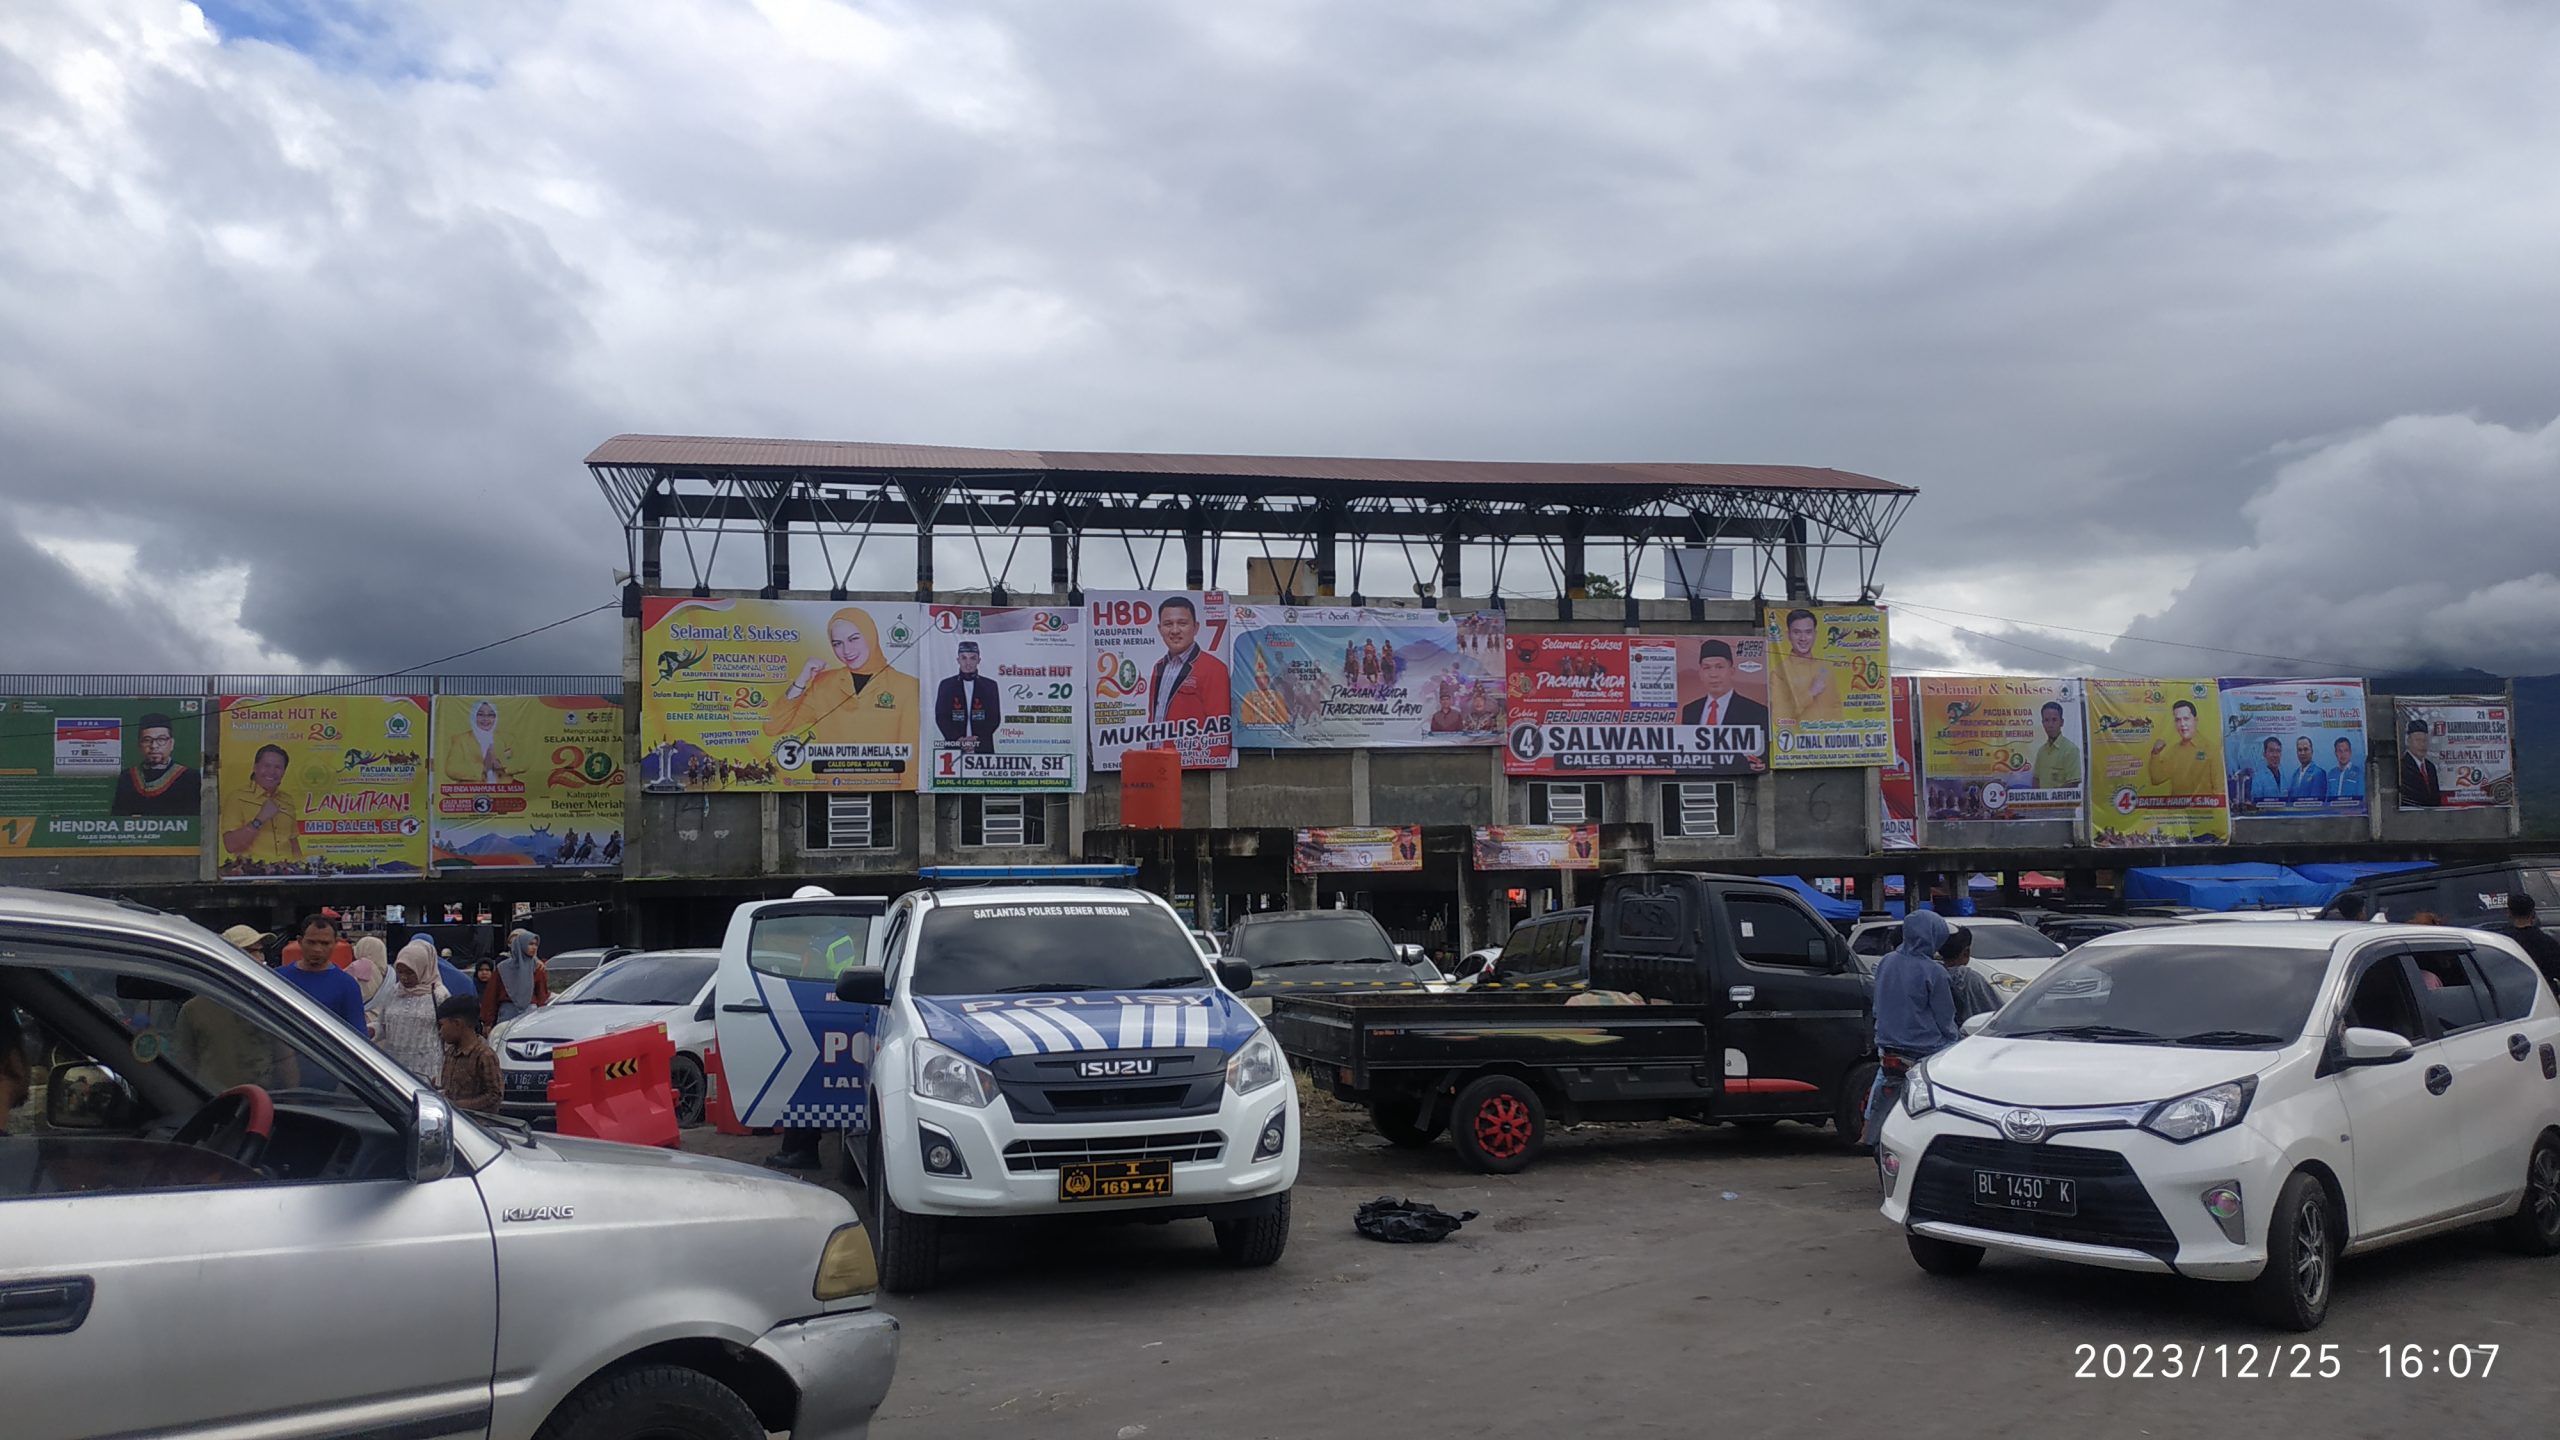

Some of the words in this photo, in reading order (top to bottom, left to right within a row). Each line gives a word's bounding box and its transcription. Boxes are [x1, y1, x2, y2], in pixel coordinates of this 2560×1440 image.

[1093, 601, 1153, 626] HBD
[941, 613, 952, 629] 1
[670, 624, 729, 641] Selamat
[733, 625, 742, 639] &
[748, 625, 798, 641] Sukses
[1094, 628, 1142, 636] KABUPATEN
[1205, 619, 1228, 651] 7
[1094, 638, 1121, 646] BENER
[1123, 638, 1155, 646] MERIAH
[1506, 638, 1513, 650] 3
[1541, 638, 1583, 649] Selamat
[1591, 638, 1623, 650] Sukses
[713, 654, 755, 663] PACUAN
[758, 654, 788, 663] KUDA
[998, 665, 1046, 677] Selamat
[1049, 665, 1072, 677] HUT
[1536, 671, 1590, 689] PACUAN
[1591, 672, 1625, 690] KUDA
[1008, 684, 1034, 699] Ke
[1048, 683, 1072, 699] 20
[1927, 683, 1982, 695] Selamat
[2005, 683, 2053, 695] Sukses
[697, 691, 720, 701] HUT
[1320, 700, 1389, 716] TRADISIONAL
[1391, 699, 1422, 716] GAYO
[1983, 708, 2011, 716] PACUAN
[2014, 708, 2033, 716] KUDA
[2322, 709, 2336, 717] HUT
[231, 708, 283, 720] Selamat
[288, 708, 315, 720] HUT
[321, 708, 337, 720] Ke
[1546, 711, 1619, 723] PERJUANGAN
[1622, 711, 1676, 723] BERSAMA
[2477, 711, 2485, 719] 21
[1099, 716, 1232, 746] MUKHLIS.AB
[1200, 736, 1228, 748] Guru
[1519, 729, 1534, 756] 4
[1548, 727, 1684, 752] SALWANI,
[1695, 727, 1755, 750] SKM
[1782, 733, 1790, 750] 7
[1796, 735, 1822, 749] IZNAL
[1825, 735, 1863, 749] KUDUMI,
[783, 745, 797, 766] 3
[808, 746, 833, 757] DIANA
[836, 746, 859, 756] PUTRI
[861, 746, 893, 758] AMELIA,
[895, 746, 908, 756] S.M
[2439, 750, 2482, 760] SELAMAT
[2486, 750, 2505, 760] HUT
[940, 752, 955, 775] 1
[965, 756, 1037, 771] SALIHIN,
[1042, 757, 1064, 770] SH
[1562, 755, 1611, 765] CALEG
[1615, 755, 1656, 765] DPRA
[1673, 755, 1715, 765] DAPIL
[1720, 755, 1734, 765] IV
[1989, 791, 1997, 802] 2
[2009, 791, 2049, 801] BUSTANIL
[2052, 790, 2081, 800] ARIPIN
[2118, 792, 2131, 809] 4
[476, 799, 488, 812] 3
[551, 800, 585, 809] Bener
[587, 800, 625, 809] Meriah
[50, 821, 119, 832] HENDRA
[124, 820, 188, 832] BUDIAN
[304, 820, 334, 833] MHD
[336, 820, 380, 833] SALEH,
[382, 820, 397, 833] SE
[1898, 821, 1911, 833] ISA
[974, 907, 1026, 919] SATLANTAS
[1027, 906, 1062, 916] POLRES
[1063, 906, 1094, 915] BENER
[1095, 906, 1130, 916] MERIAH
[1081, 1060, 1152, 1076] ISUZU
[514, 1073, 532, 1084] 1162
[537, 1073, 548, 1084] CZ
[1979, 1174, 1997, 1194] BL
[2007, 1177, 2042, 1199] 1450
[2060, 1182, 2070, 1202] K
[502, 1206, 575, 1222] KIJANG
